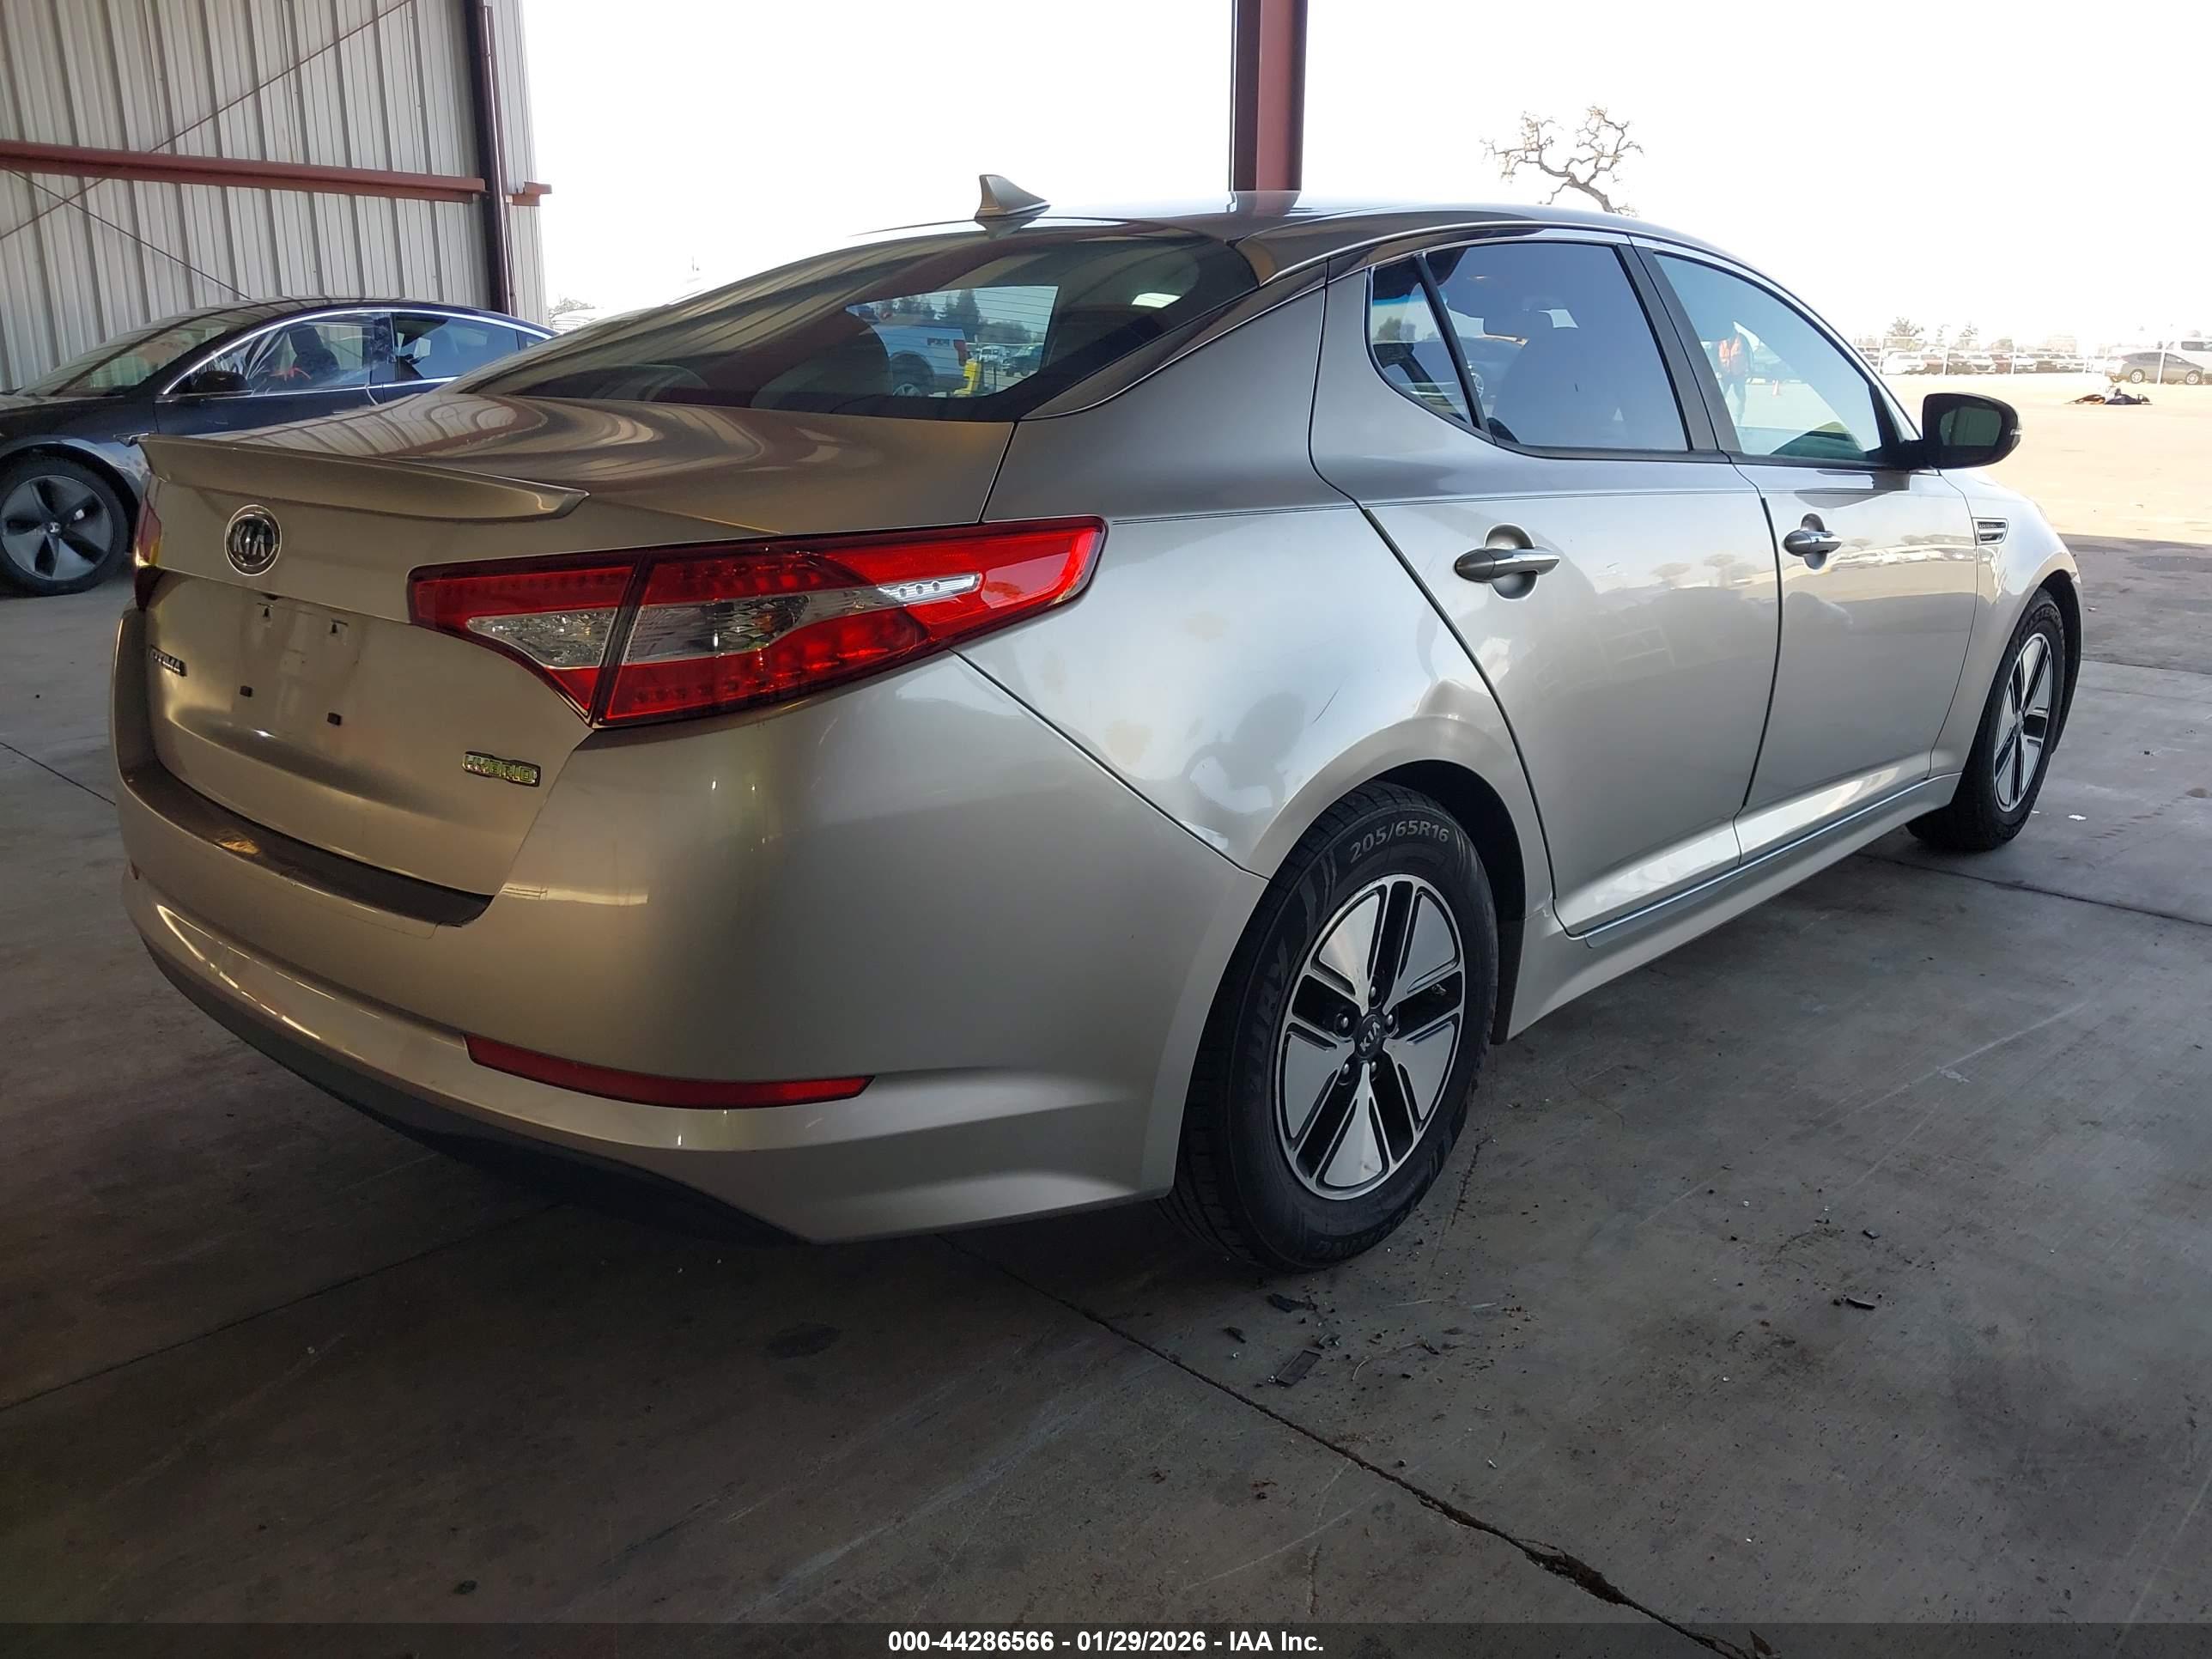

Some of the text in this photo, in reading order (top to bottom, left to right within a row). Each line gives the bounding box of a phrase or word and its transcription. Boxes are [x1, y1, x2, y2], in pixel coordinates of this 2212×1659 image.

[233, 524, 266, 557] KIA
[1350, 820, 1449, 864] 205/65R16
[1359, 1021, 1381, 1052] KIA
